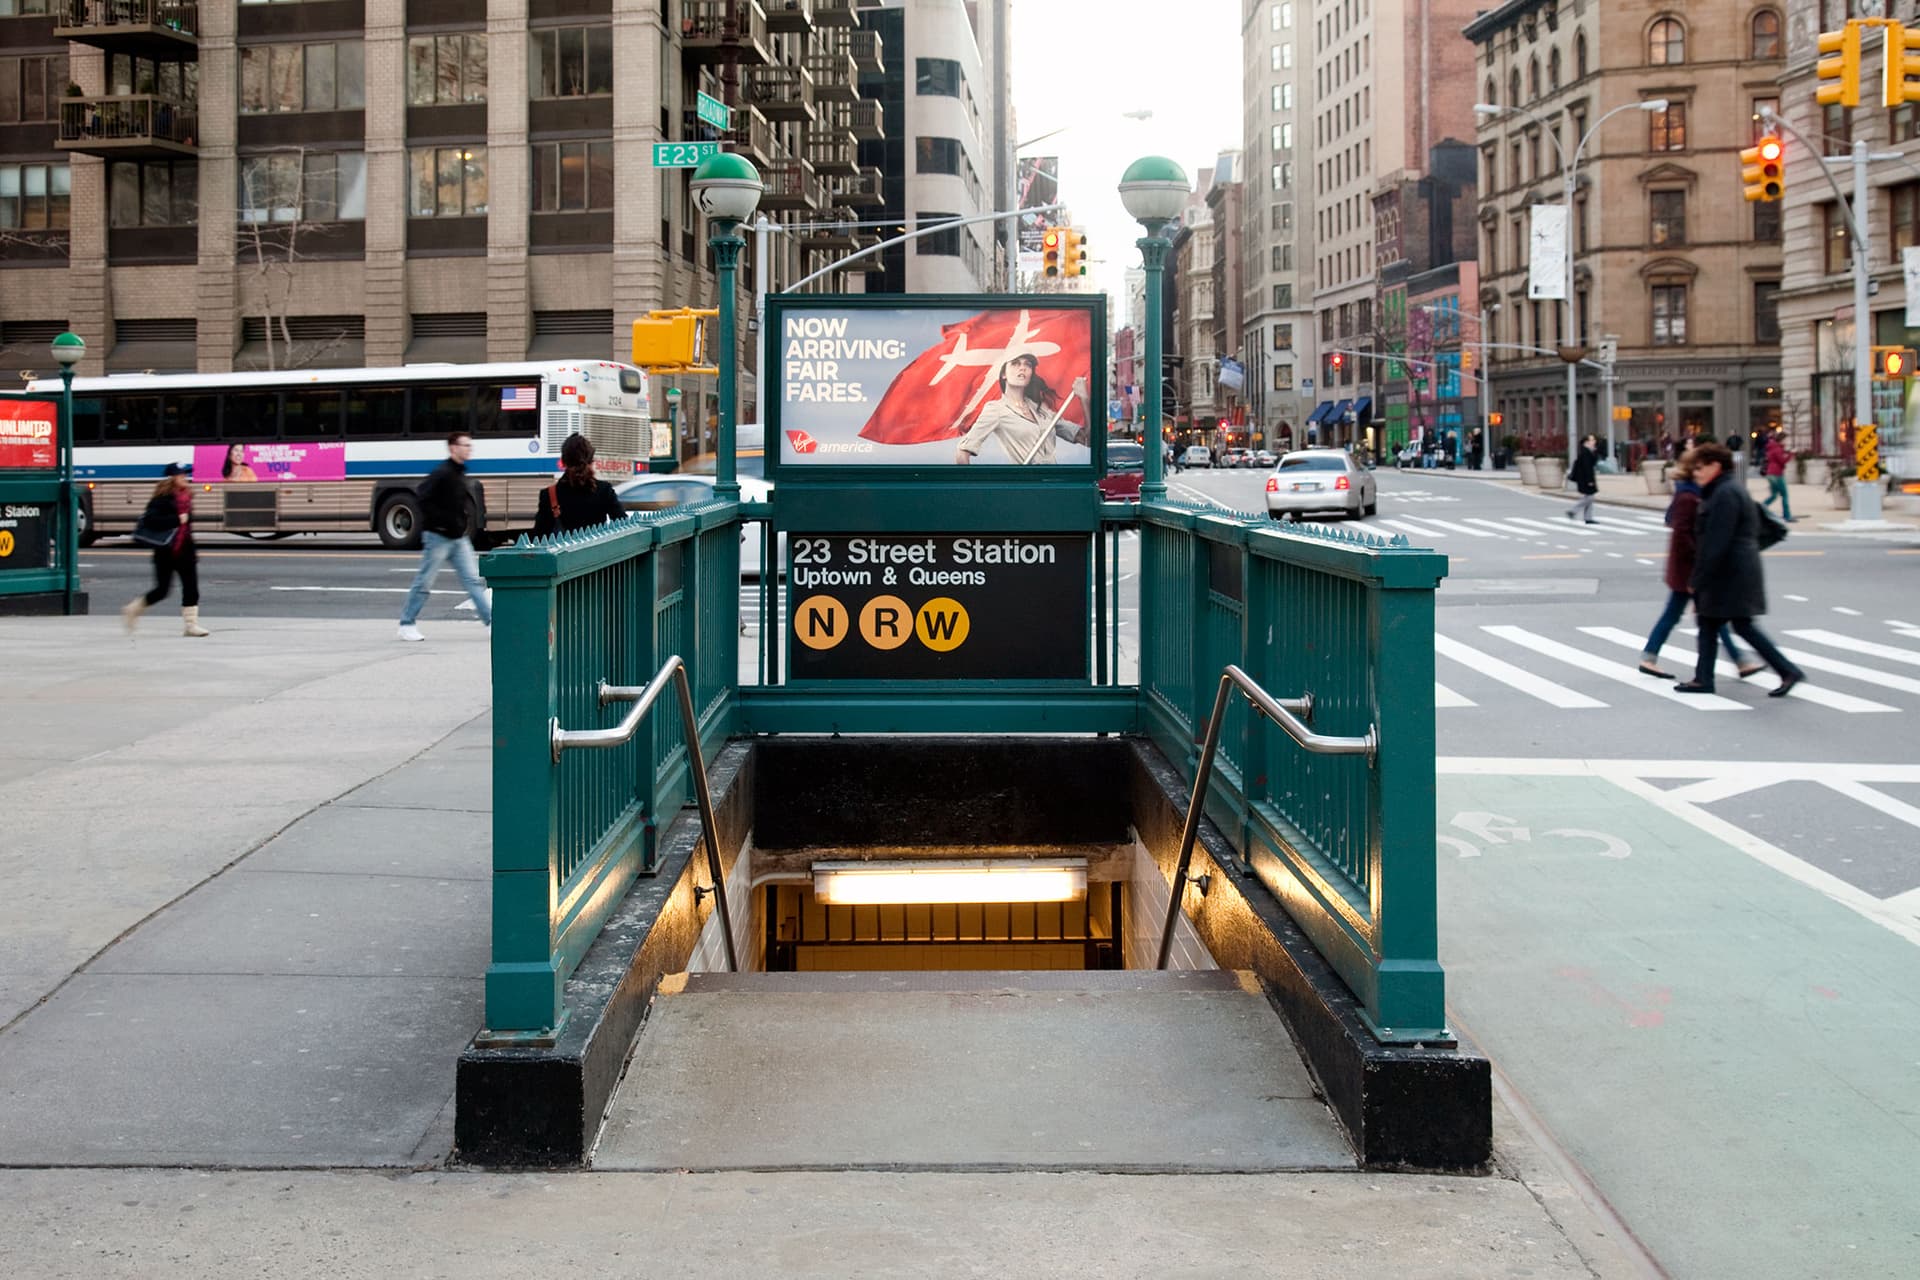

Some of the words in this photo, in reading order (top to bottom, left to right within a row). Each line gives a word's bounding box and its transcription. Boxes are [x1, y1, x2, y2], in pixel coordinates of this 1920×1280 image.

[702, 145, 715, 155] ST
[786, 318, 848, 338] NOW
[785, 339, 906, 359] ARRIVING:
[786, 361, 839, 381] FAIR
[786, 382, 868, 402] FARES.
[0, 420, 52, 436] UNLIMITED
[819, 440, 873, 453] america
[267, 462, 291, 472] YOU
[5, 505, 40, 517] Station
[793, 539, 831, 564] 23
[848, 539, 936, 564] Street
[952, 539, 1055, 564] Station
[793, 567, 871, 589] Uptown
[882, 566, 897, 586] &
[908, 567, 986, 586] Queens
[808, 608, 834, 637] N
[875, 608, 899, 637] R
[923, 611, 959, 640] W
